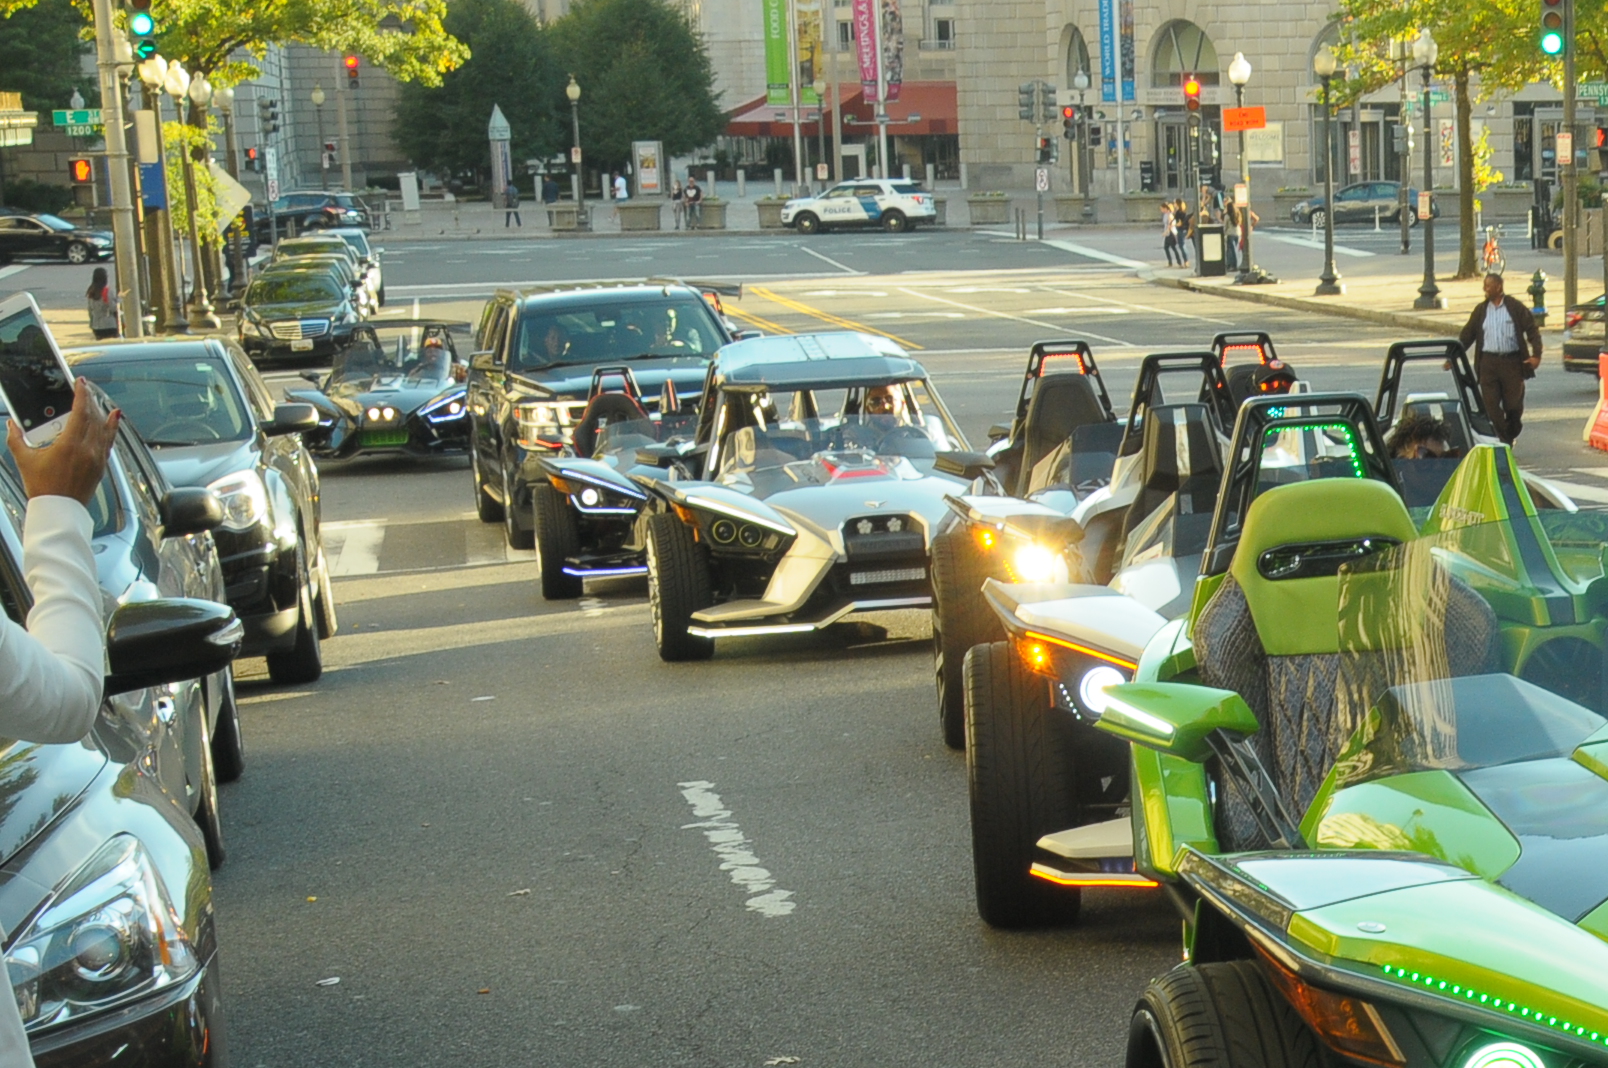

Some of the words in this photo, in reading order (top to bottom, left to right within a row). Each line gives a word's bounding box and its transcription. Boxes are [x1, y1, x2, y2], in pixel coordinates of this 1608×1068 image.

[769, 9, 781, 39] FOOD
[1102, 34, 1111, 75] WORLD
[66, 112, 76, 123] E
[68, 126, 91, 136] 1200
